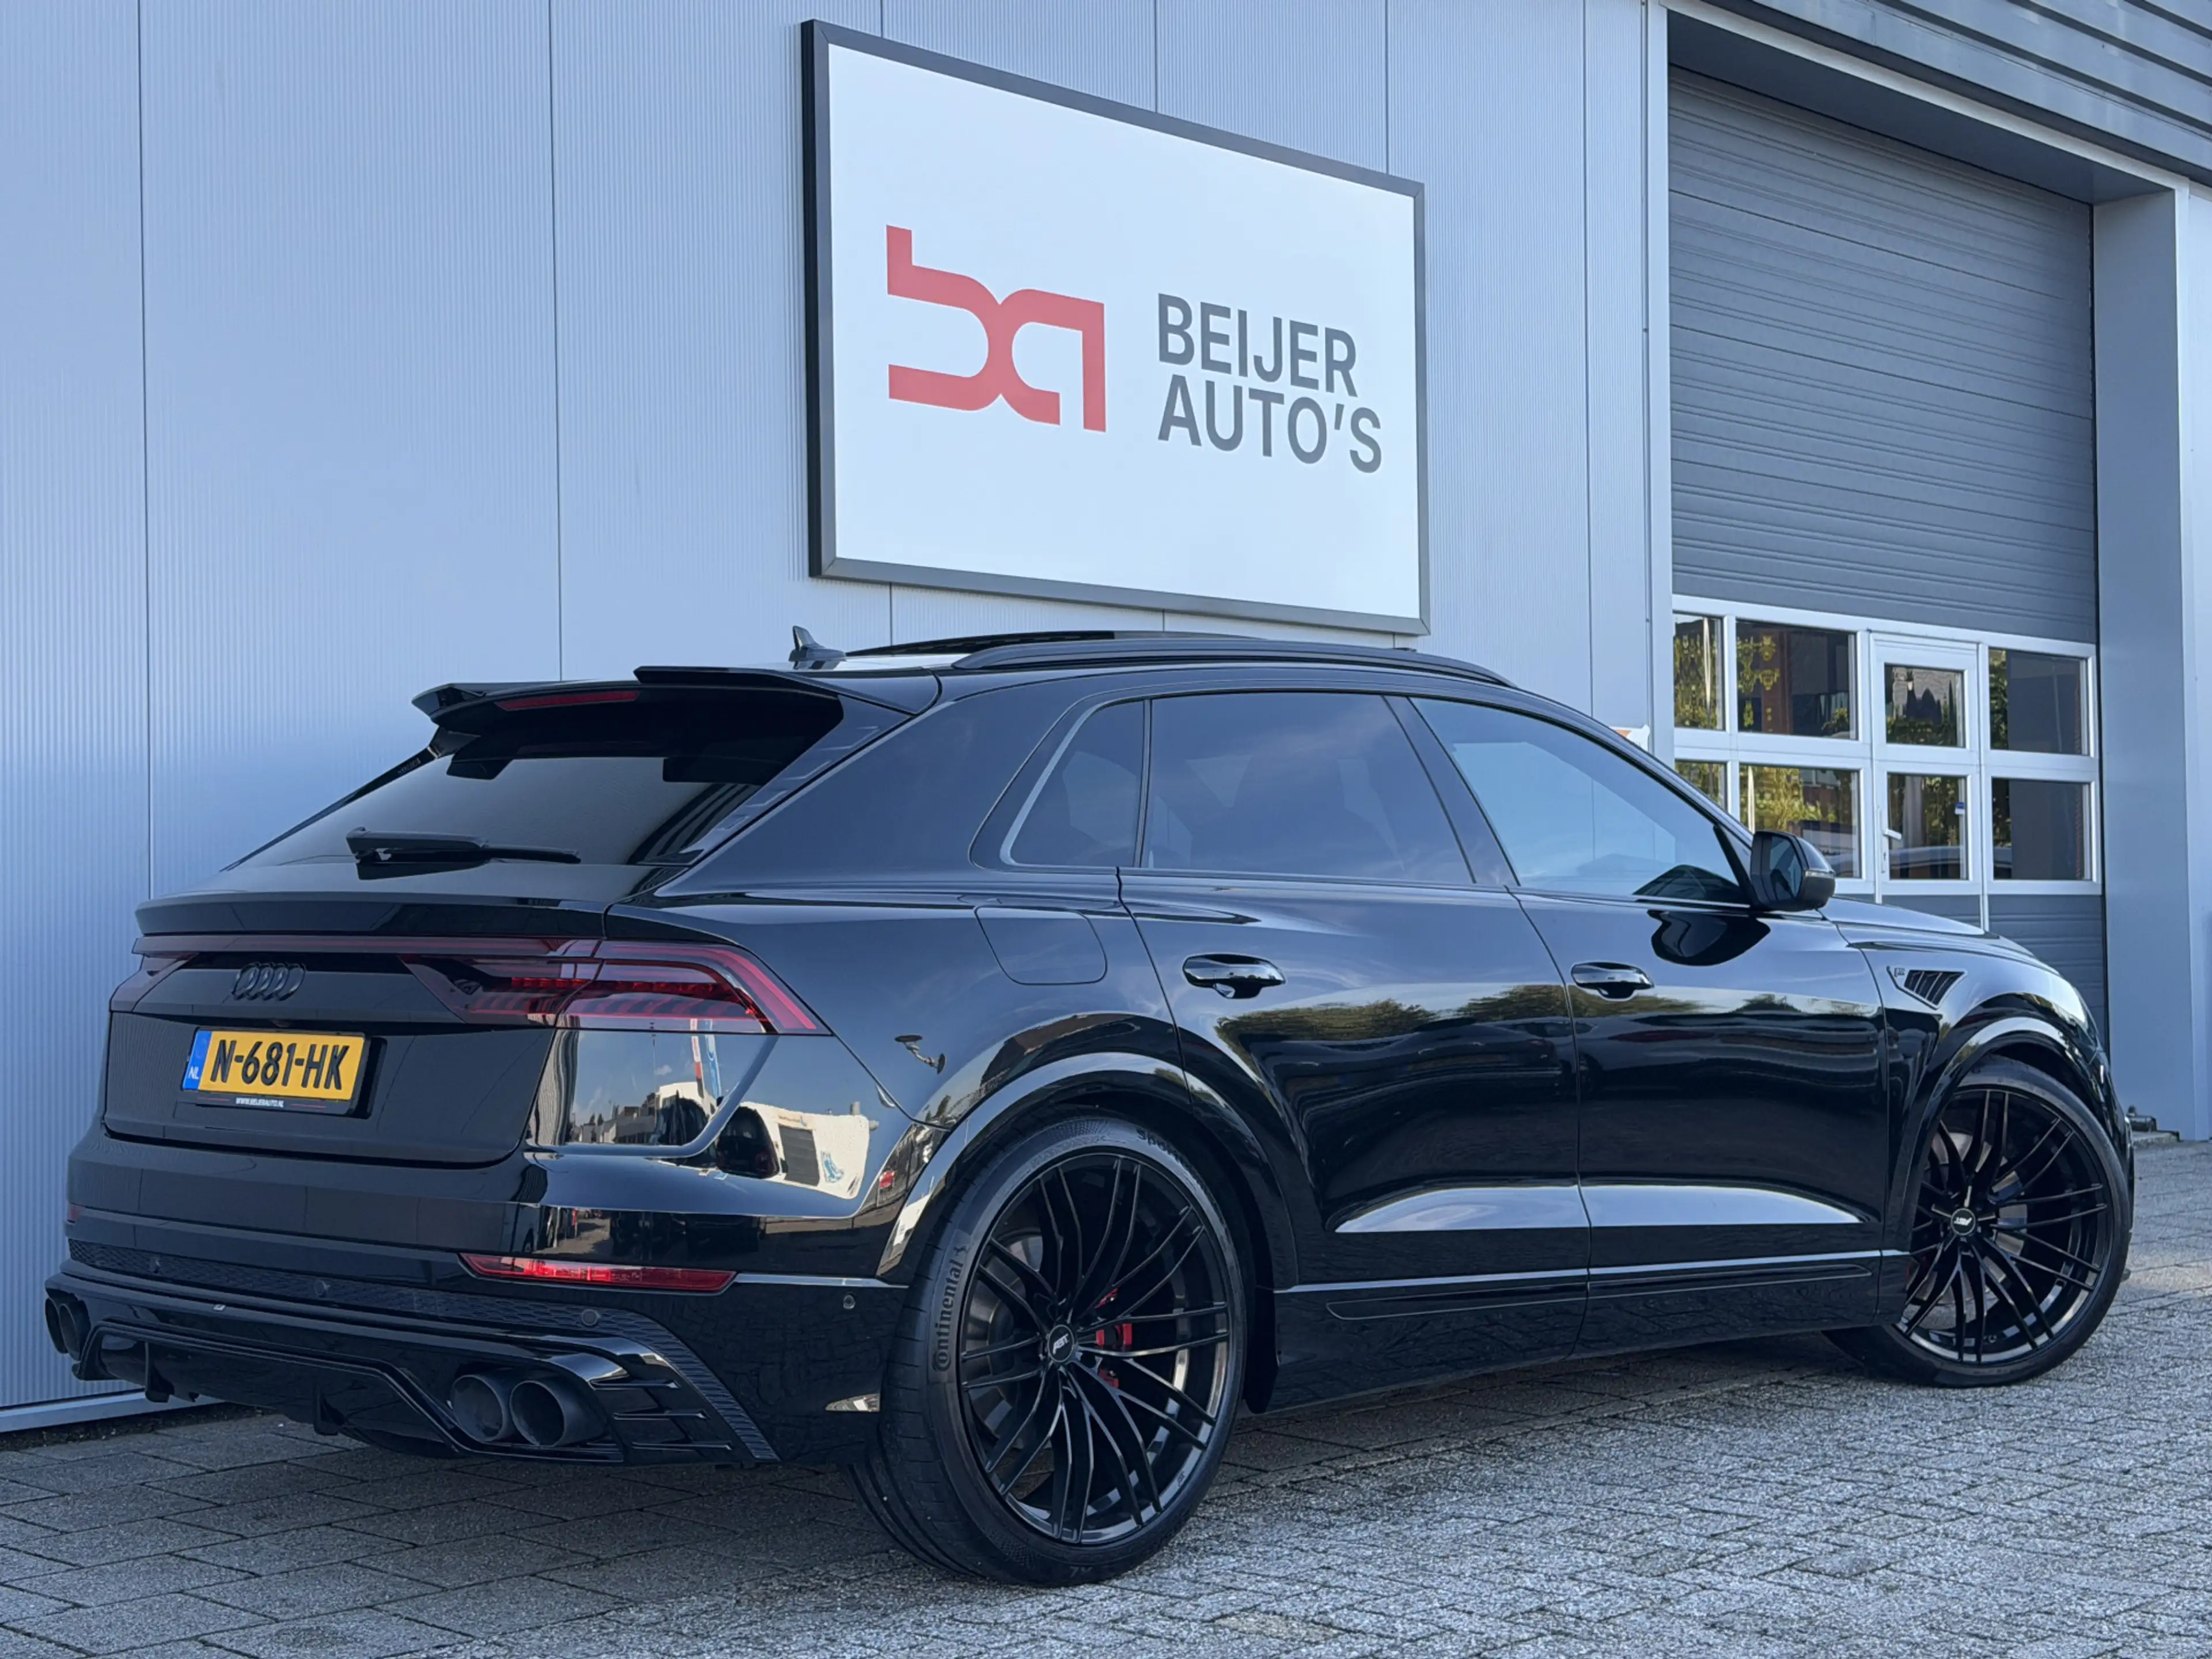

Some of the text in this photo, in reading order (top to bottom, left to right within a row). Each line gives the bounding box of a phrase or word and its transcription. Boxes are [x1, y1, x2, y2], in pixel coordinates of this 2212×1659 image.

[1158, 293, 1358, 397] BEIJER
[1158, 374, 1381, 473] AUTO'S
[188, 1066, 199, 1079] NL
[210, 1039, 350, 1090] N-681-HK
[931, 1259, 964, 1372] Continental
